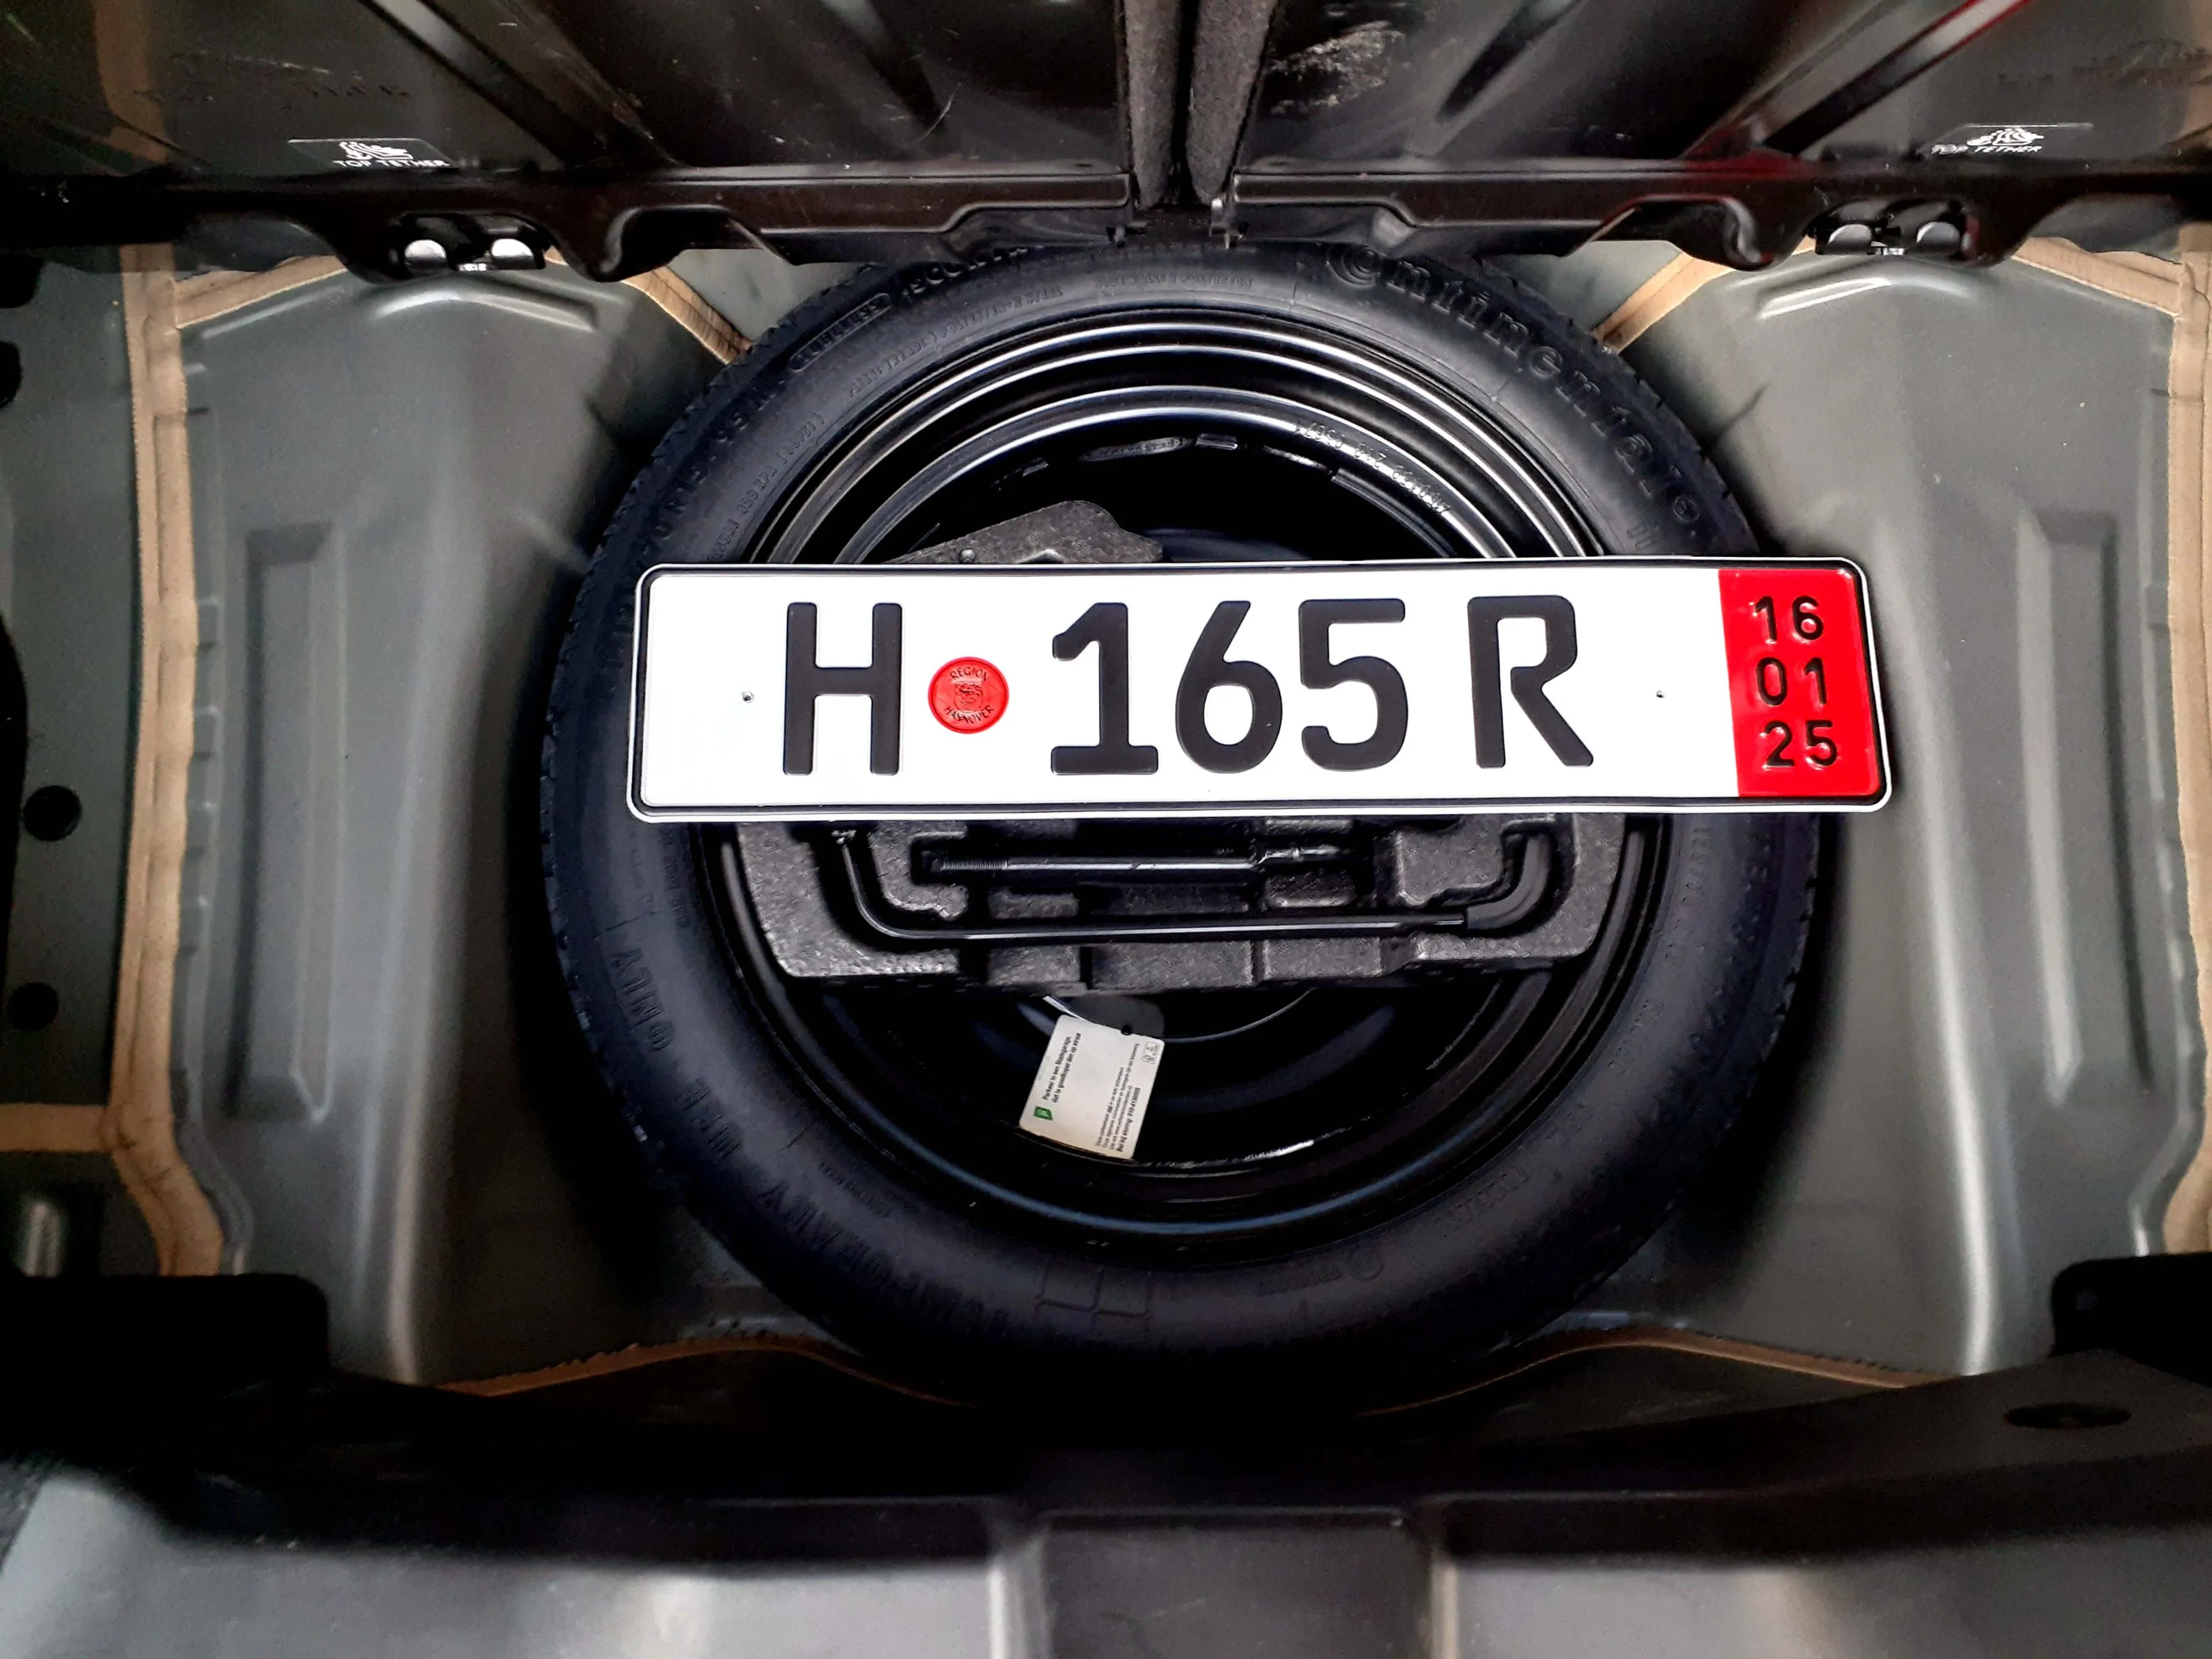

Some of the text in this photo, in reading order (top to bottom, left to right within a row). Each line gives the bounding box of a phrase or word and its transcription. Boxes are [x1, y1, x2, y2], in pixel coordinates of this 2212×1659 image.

[1755, 595, 1824, 642] 16
[783, 595, 1593, 775] H 165 R
[1755, 657, 1827, 707] 01
[1763, 719, 1839, 768] 25
